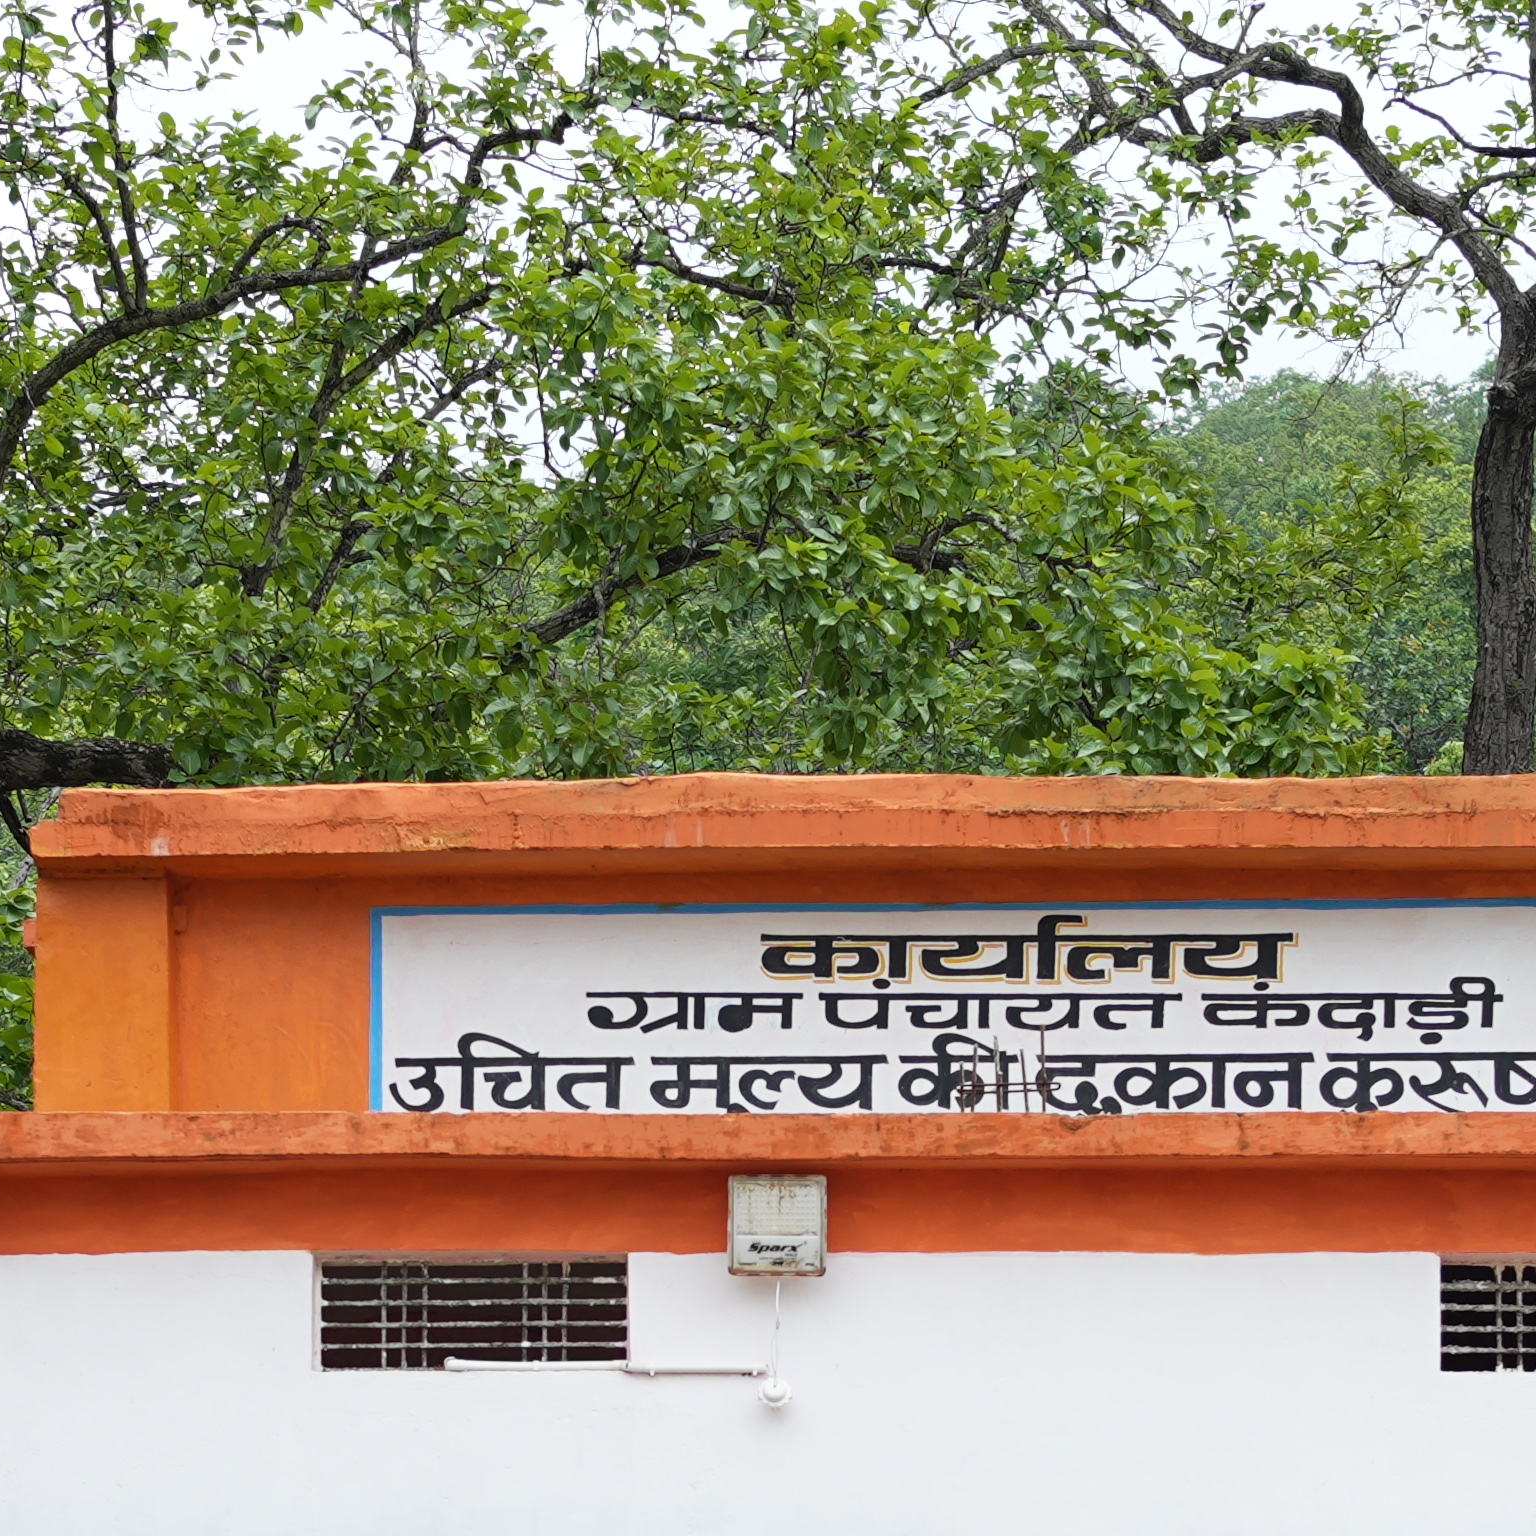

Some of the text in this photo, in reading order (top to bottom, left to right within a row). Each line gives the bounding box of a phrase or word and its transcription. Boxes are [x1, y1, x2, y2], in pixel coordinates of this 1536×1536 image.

[760, 915, 1298, 984] कार्यालय
[586, 976, 1503, 1045] ग्राम पंचायत कंदाड़ी
[389, 1032, 634, 1112] उचित
[898, 1033, 1019, 1111] की
[747, 1241, 804, 1254] Sparx
